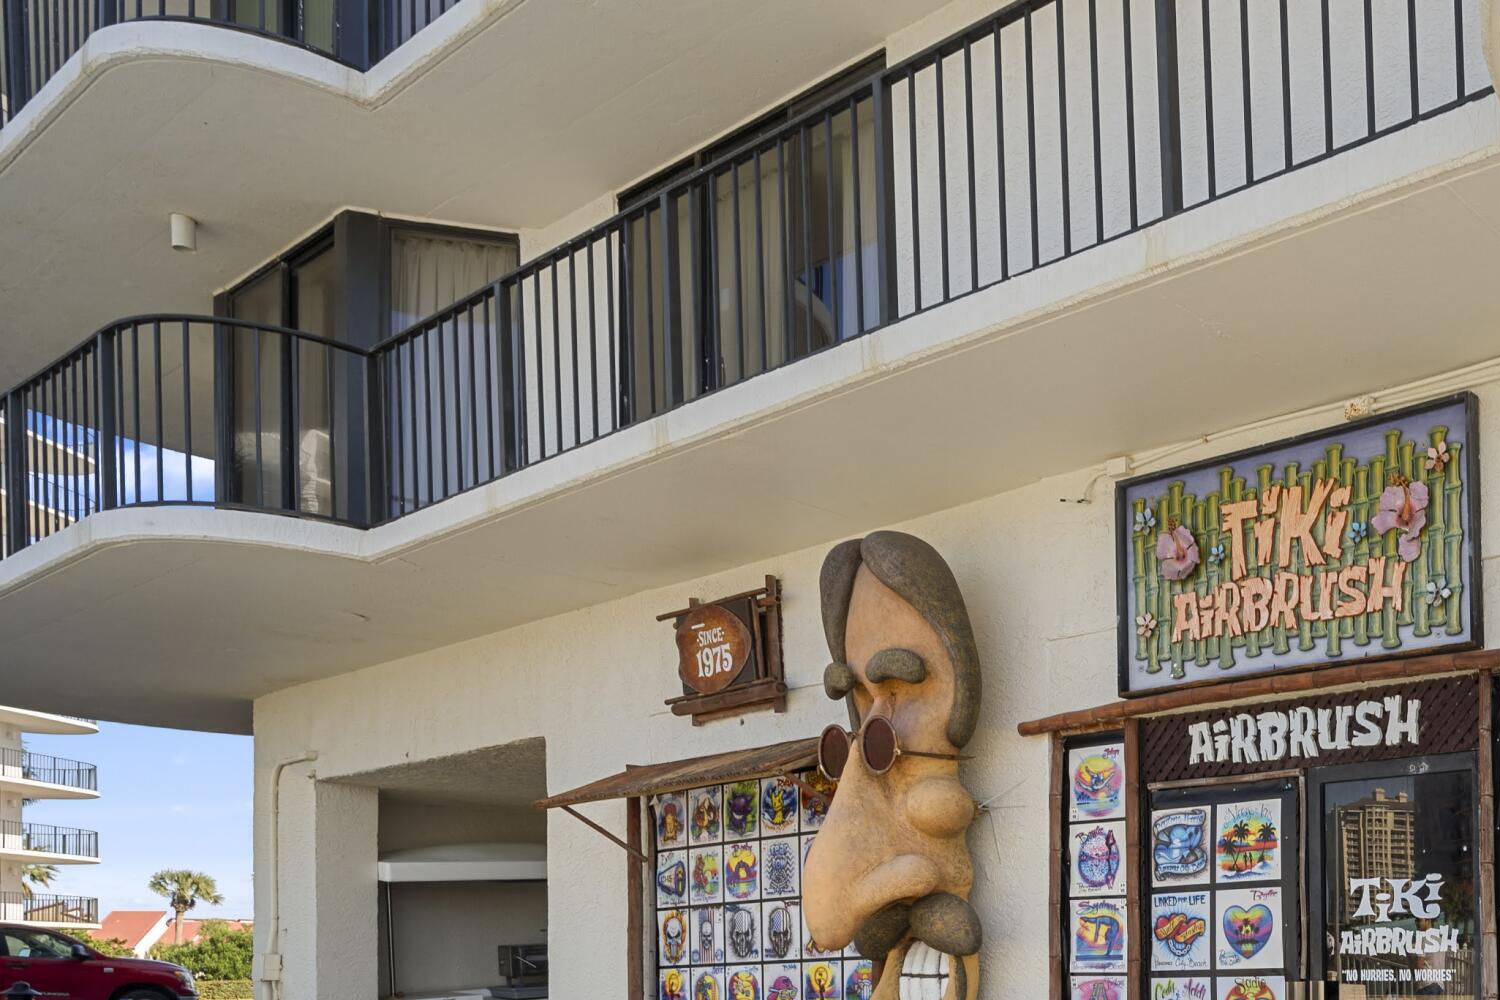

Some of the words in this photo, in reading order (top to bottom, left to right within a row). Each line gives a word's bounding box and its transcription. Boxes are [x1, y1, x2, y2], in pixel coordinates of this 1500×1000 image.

[696, 643, 733, 677] 1975
[1154, 896, 1177, 908] LINKED
[1188, 895, 1206, 906] LIFE
[1360, 969, 1397, 982] HURRIES,
[1399, 969, 1412, 982] NO
